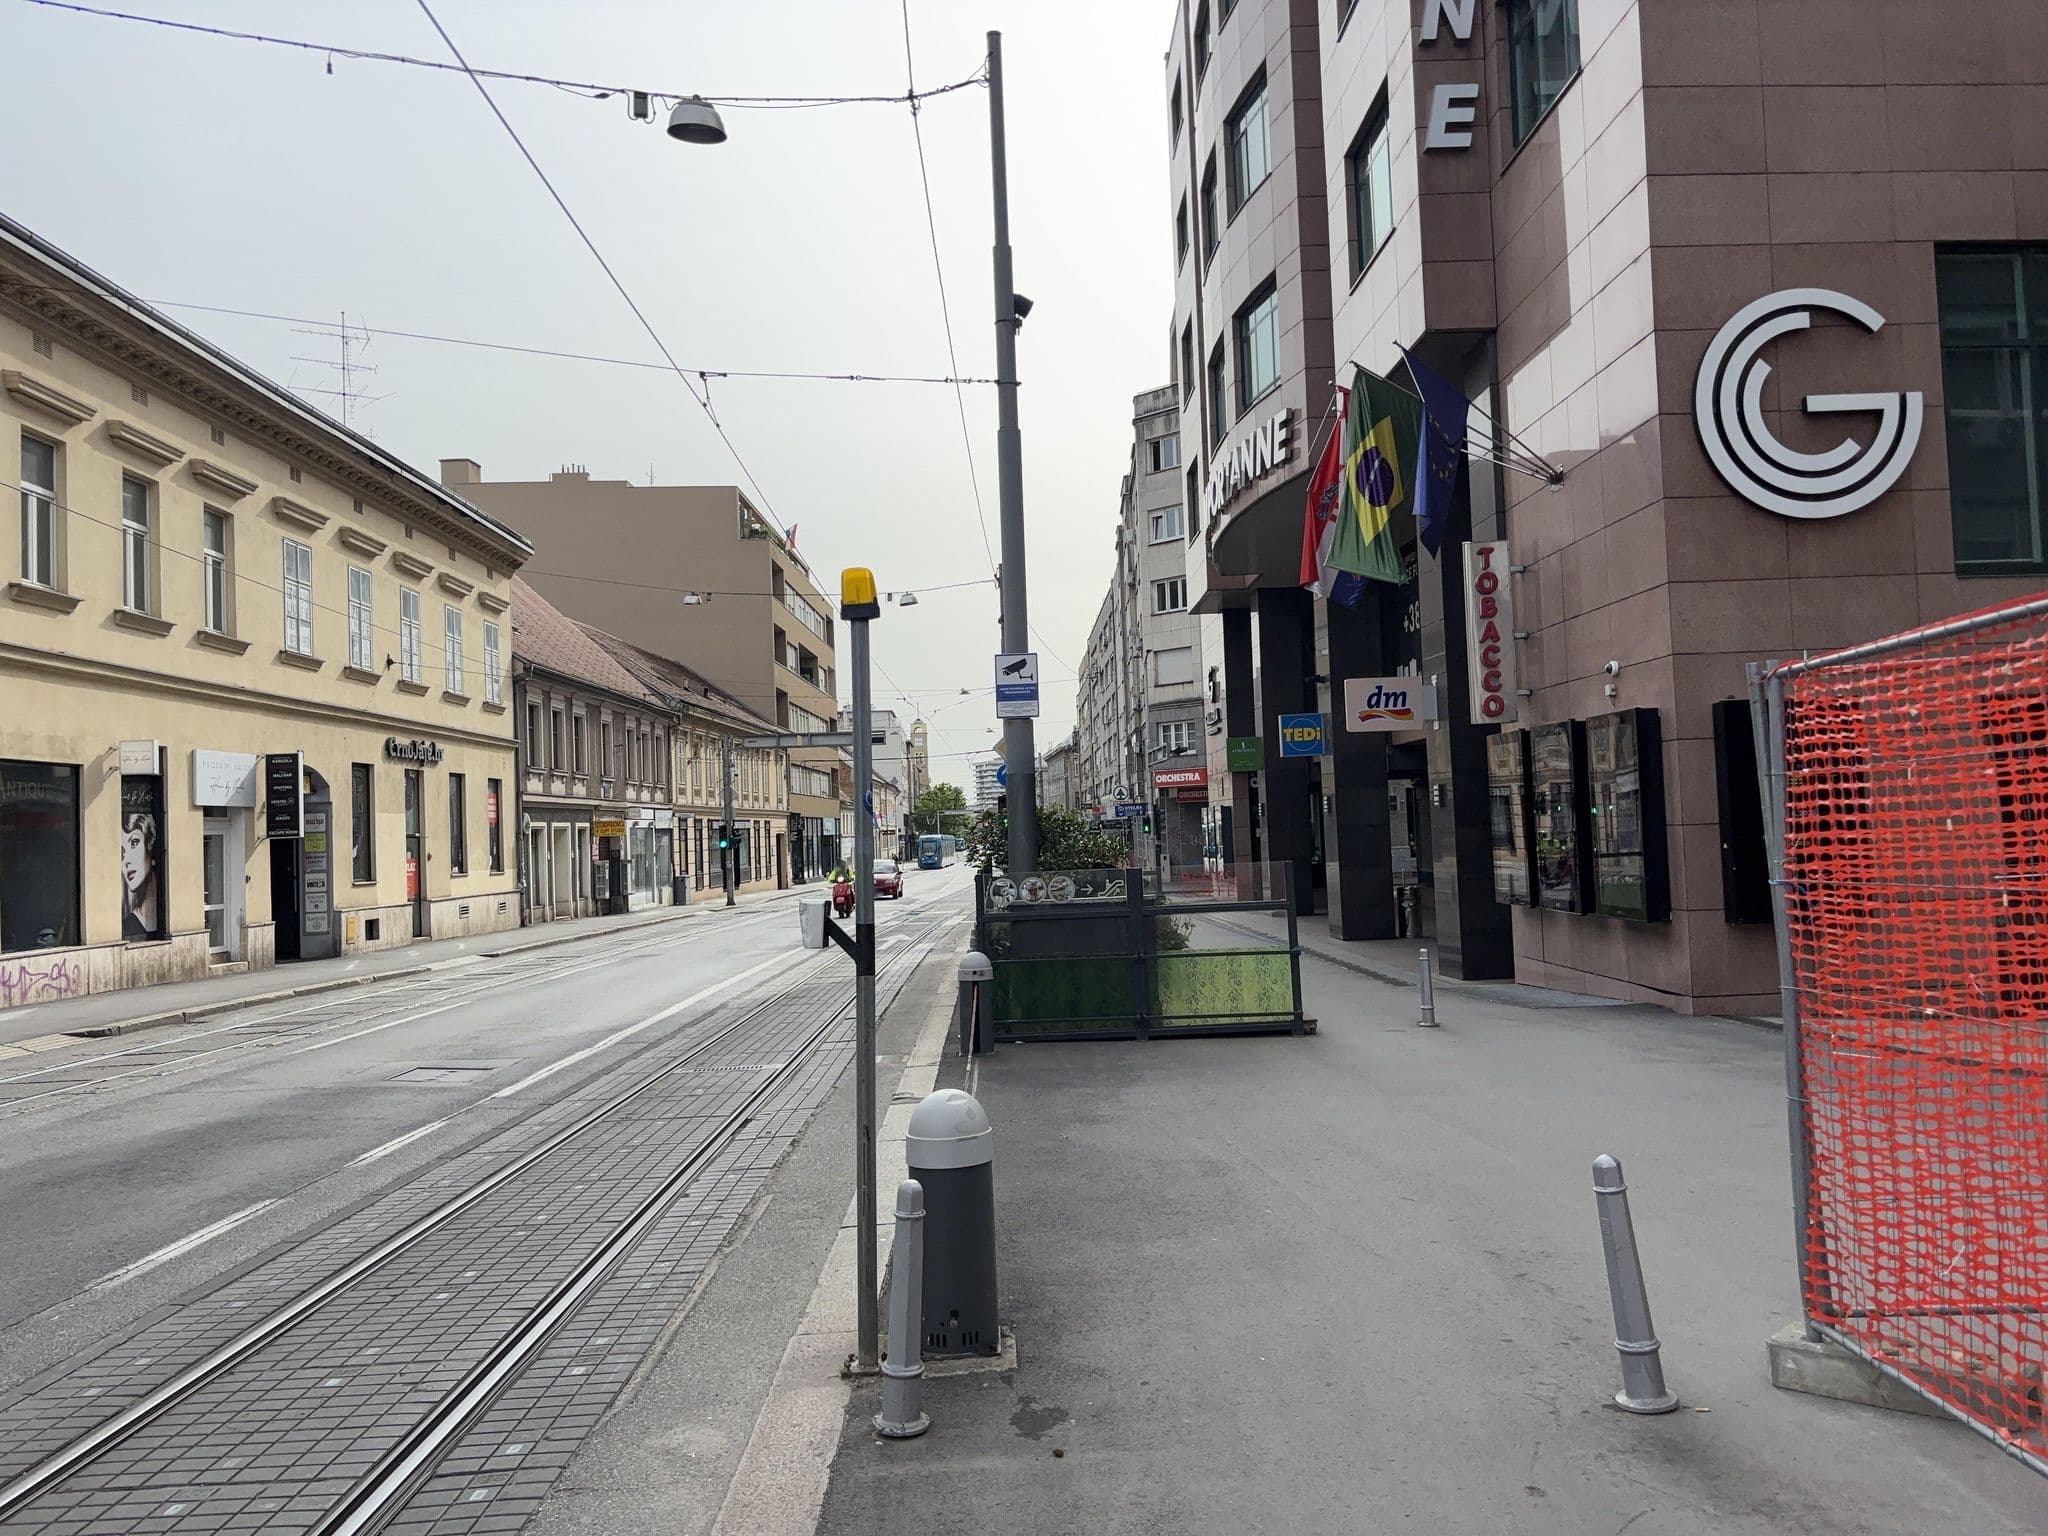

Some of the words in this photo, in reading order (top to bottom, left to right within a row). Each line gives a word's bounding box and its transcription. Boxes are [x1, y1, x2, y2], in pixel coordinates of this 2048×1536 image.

[1475, 546, 1505, 717] TOBACCO
[1366, 685, 1407, 709] dm
[1283, 727, 1321, 742] TEDi
[1155, 772, 1200, 784] ORCHESTRA
